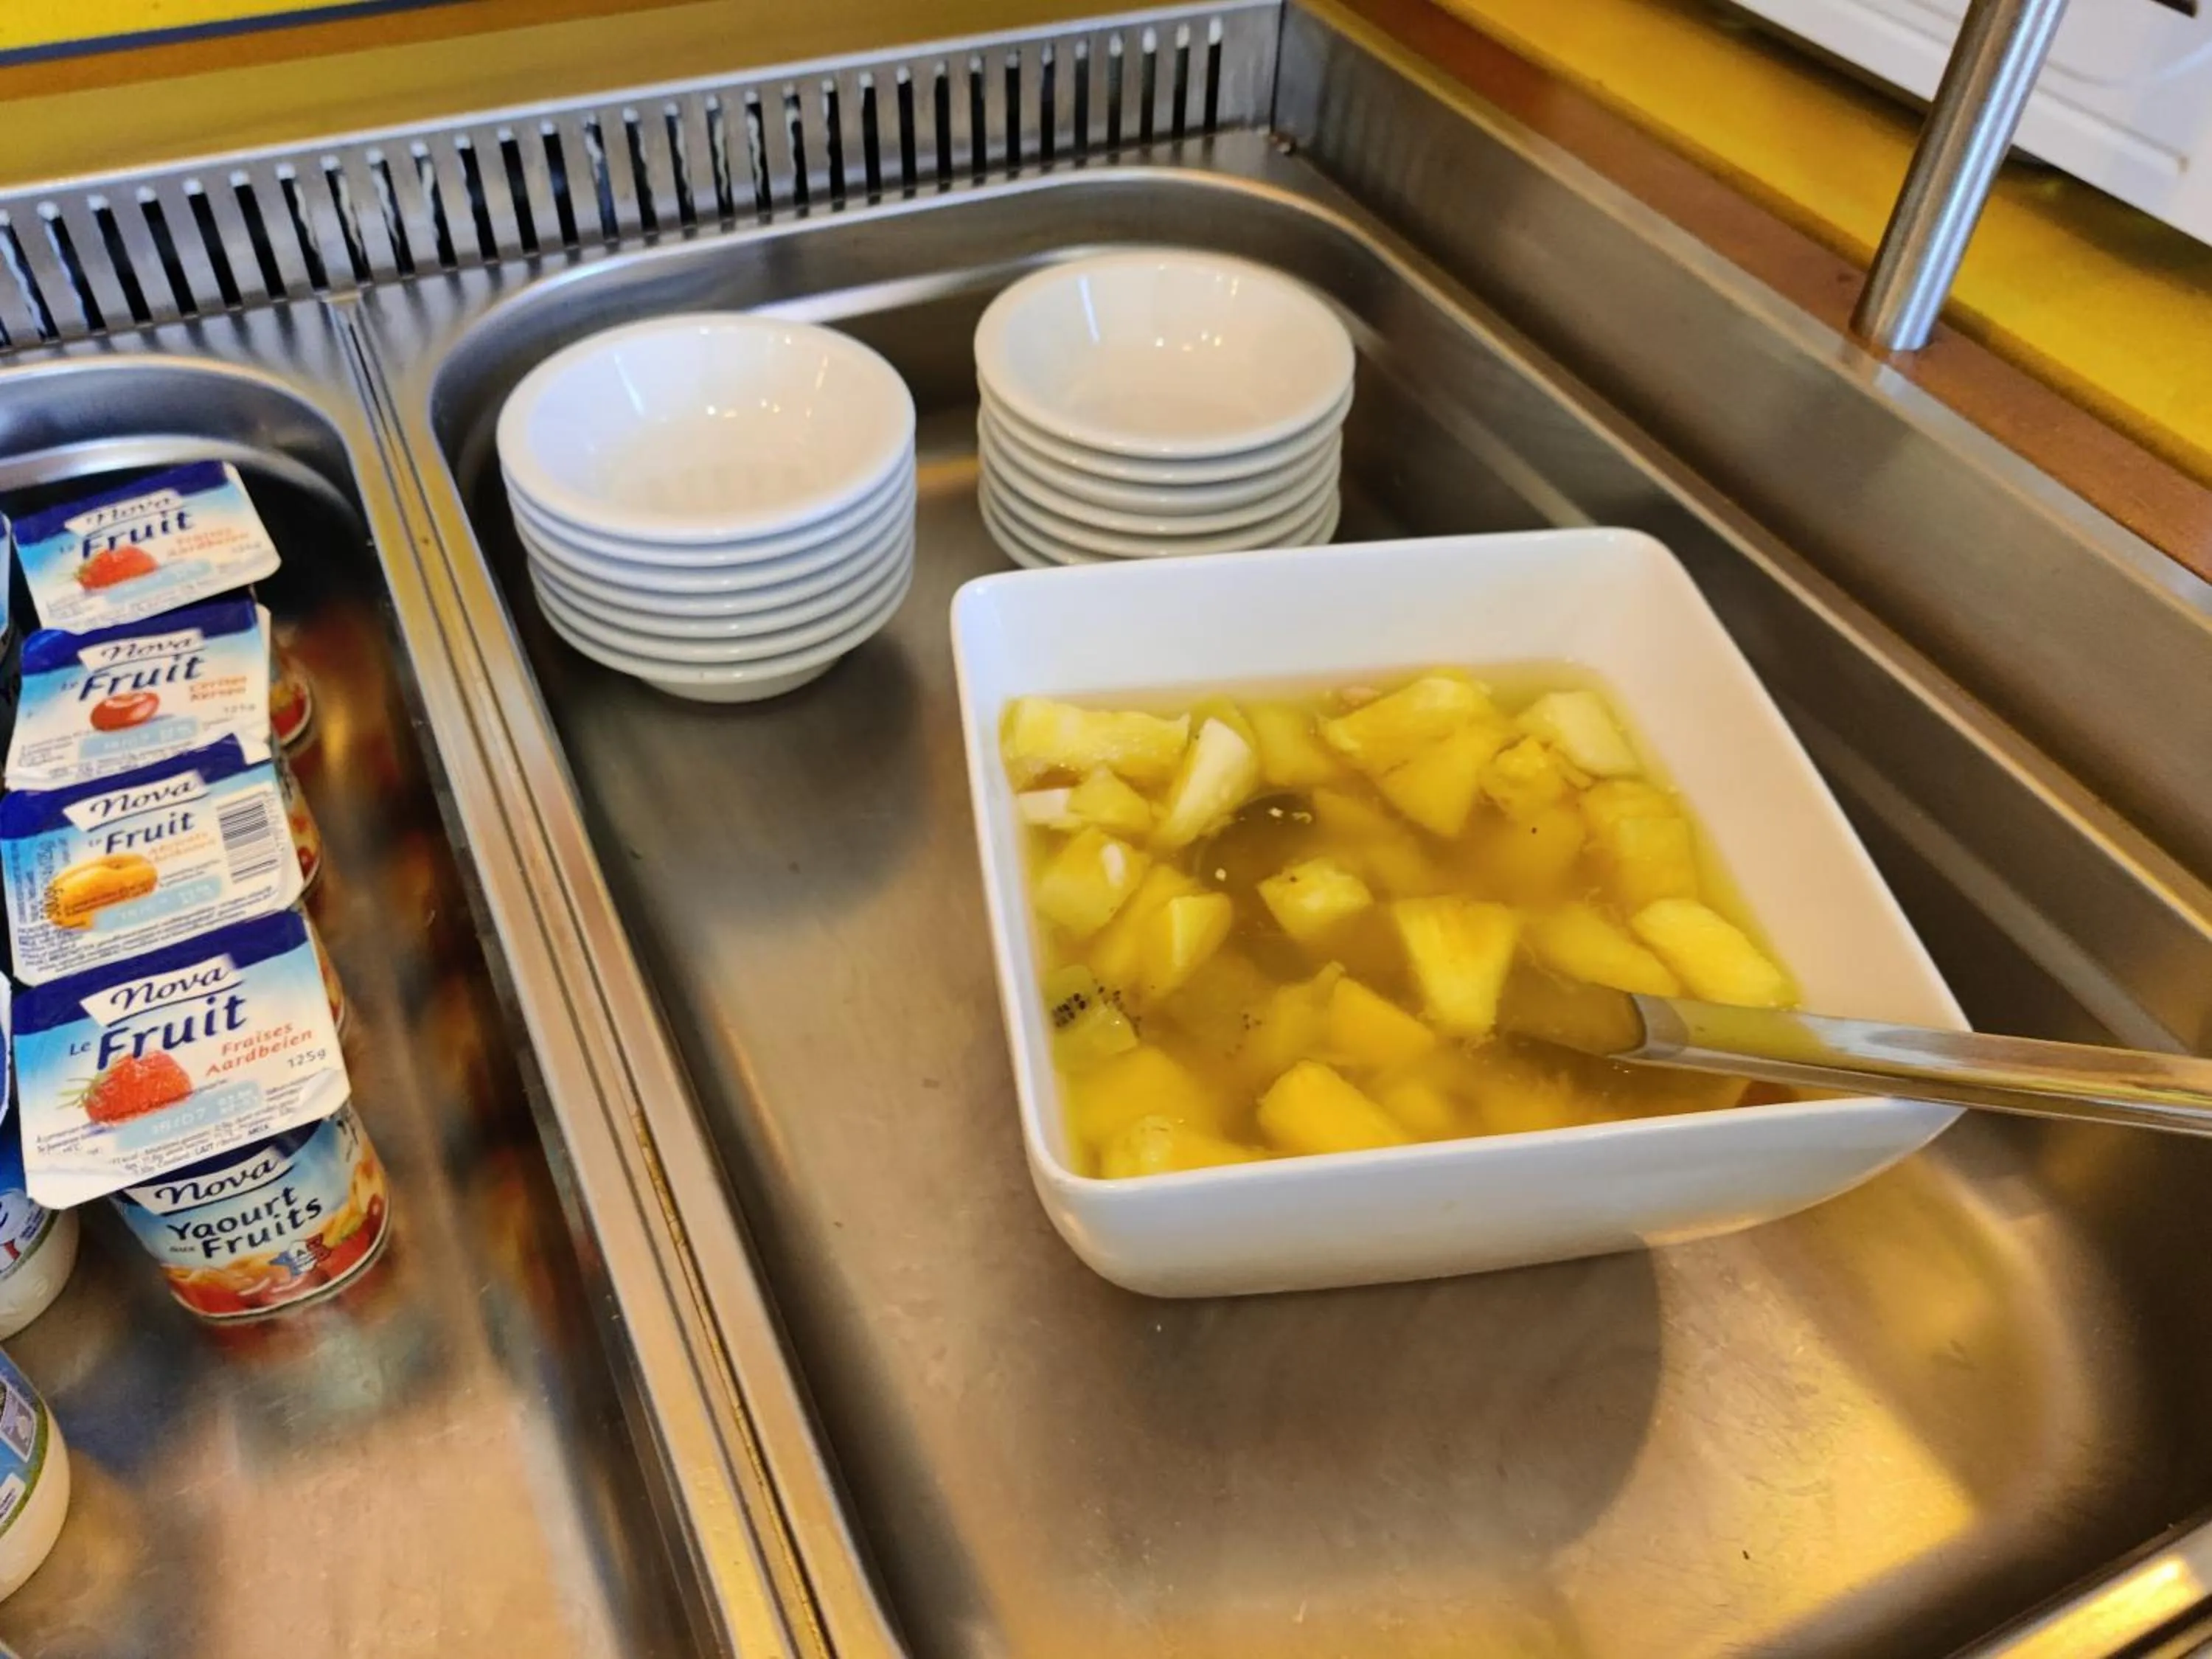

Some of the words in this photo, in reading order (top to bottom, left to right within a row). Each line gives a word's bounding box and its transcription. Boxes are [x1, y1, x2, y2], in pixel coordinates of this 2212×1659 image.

[82, 511, 193, 559] Fruit
[101, 638, 192, 661] Nova
[79, 653, 205, 701] Fruit
[89, 776, 197, 817] Nova
[105, 812, 196, 854] Fruit
[110, 964, 229, 1011] Nova
[69, 1040, 91, 1056] Le
[97, 994, 248, 1071] Fruit
[206, 1030, 313, 1077] Aardbeien
[221, 1022, 293, 1057] Fraises
[287, 1048, 327, 1070] 125g
[155, 1158, 279, 1206] Nova
[167, 1186, 299, 1240] Yaourt
[201, 1196, 323, 1259] Fruits
